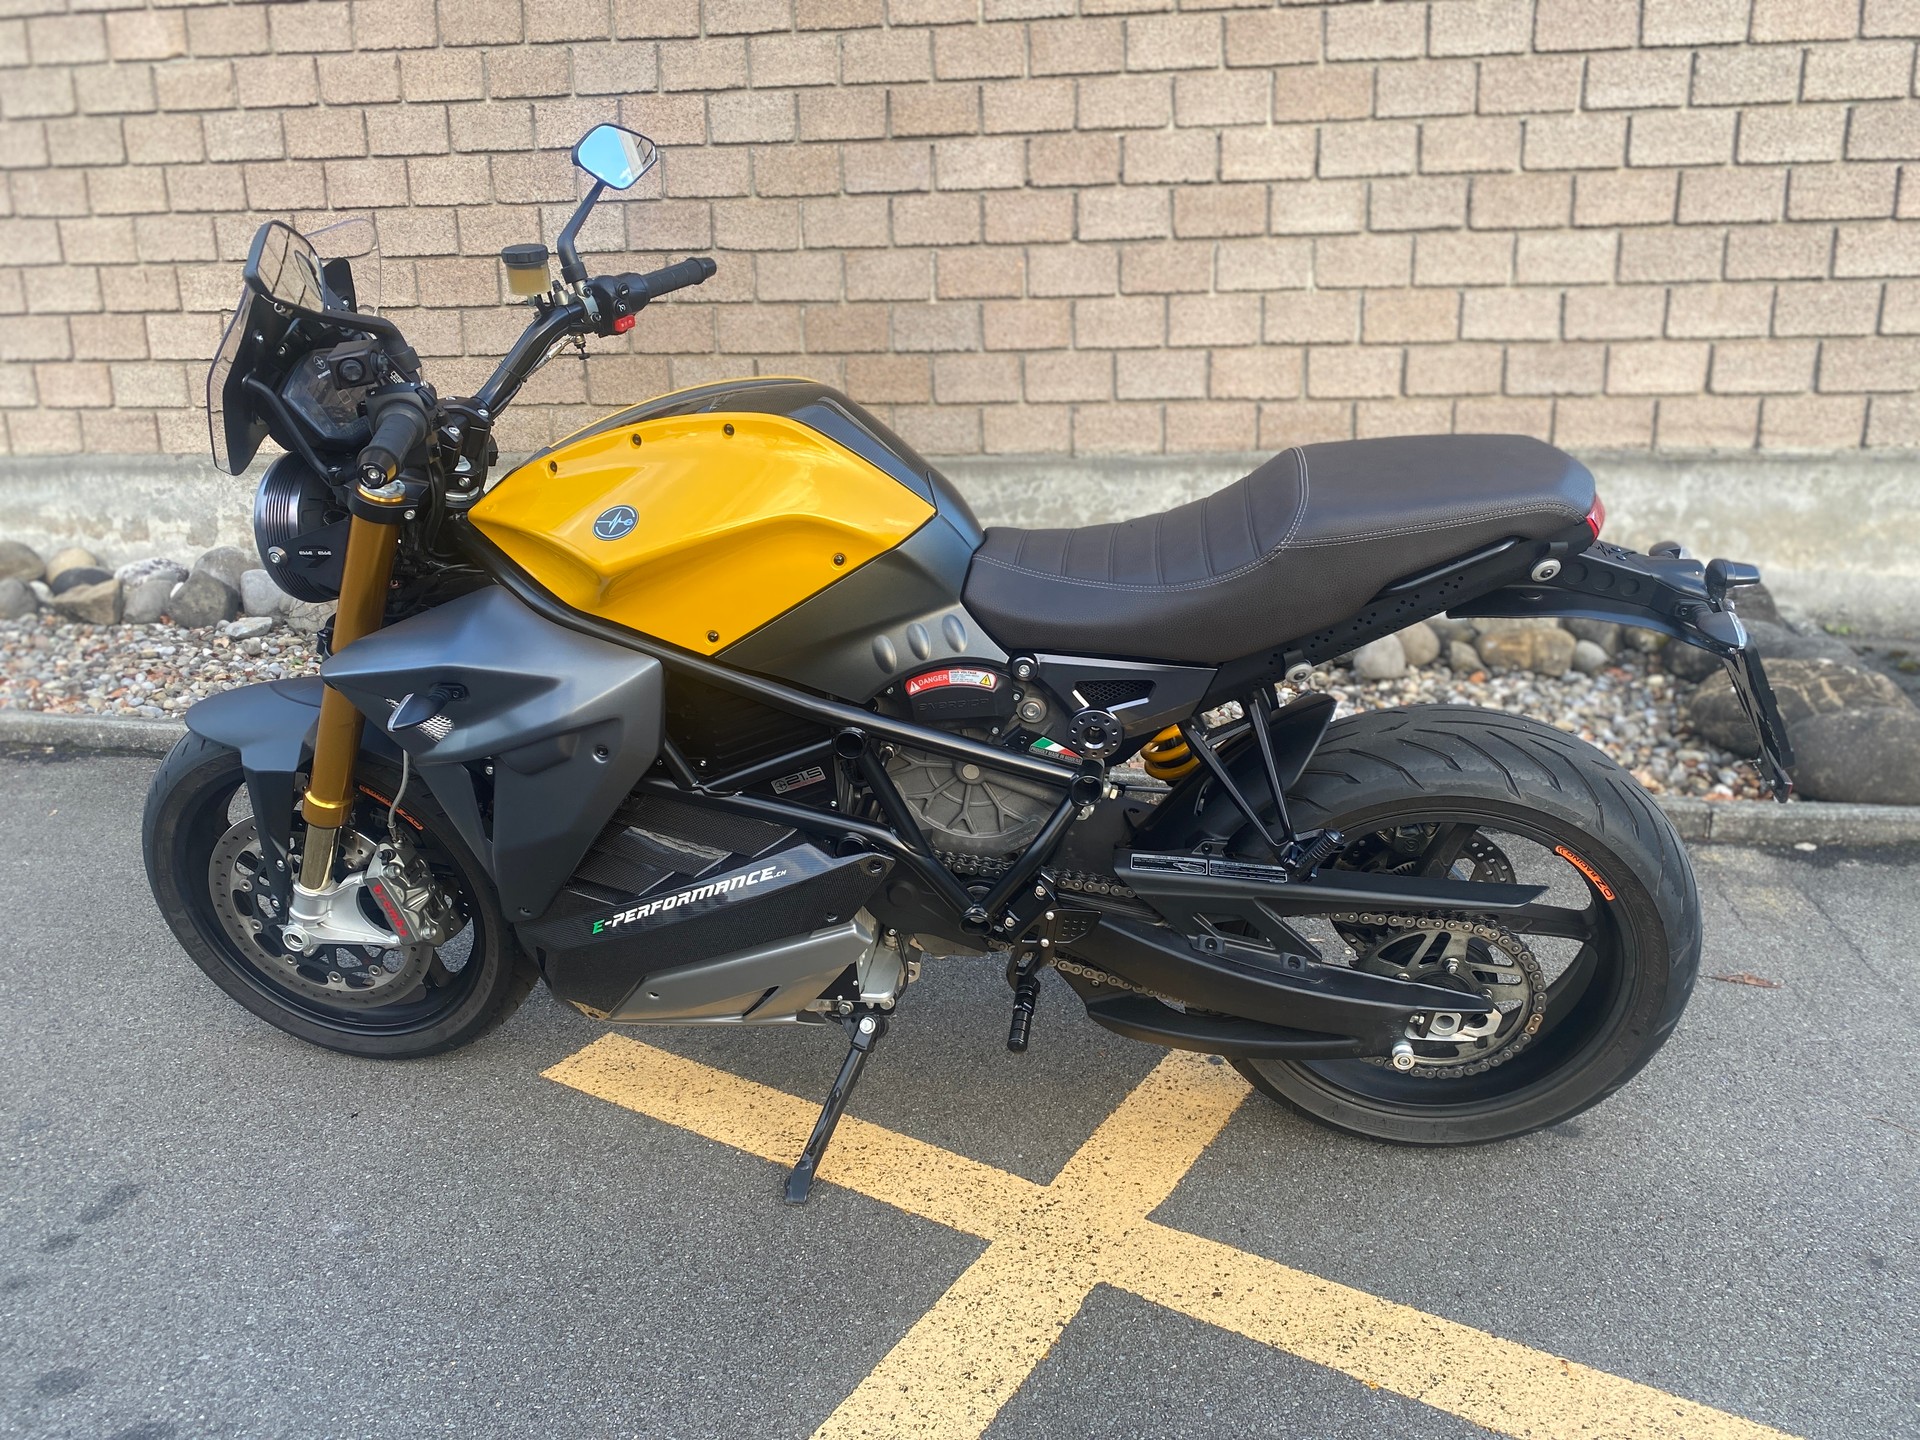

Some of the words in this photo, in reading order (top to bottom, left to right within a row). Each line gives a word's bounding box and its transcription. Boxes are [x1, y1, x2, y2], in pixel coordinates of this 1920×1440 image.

[918, 674, 948, 686] DANGER
[1566, 851, 1597, 877] RACING
[372, 884, 408, 936] brembo
